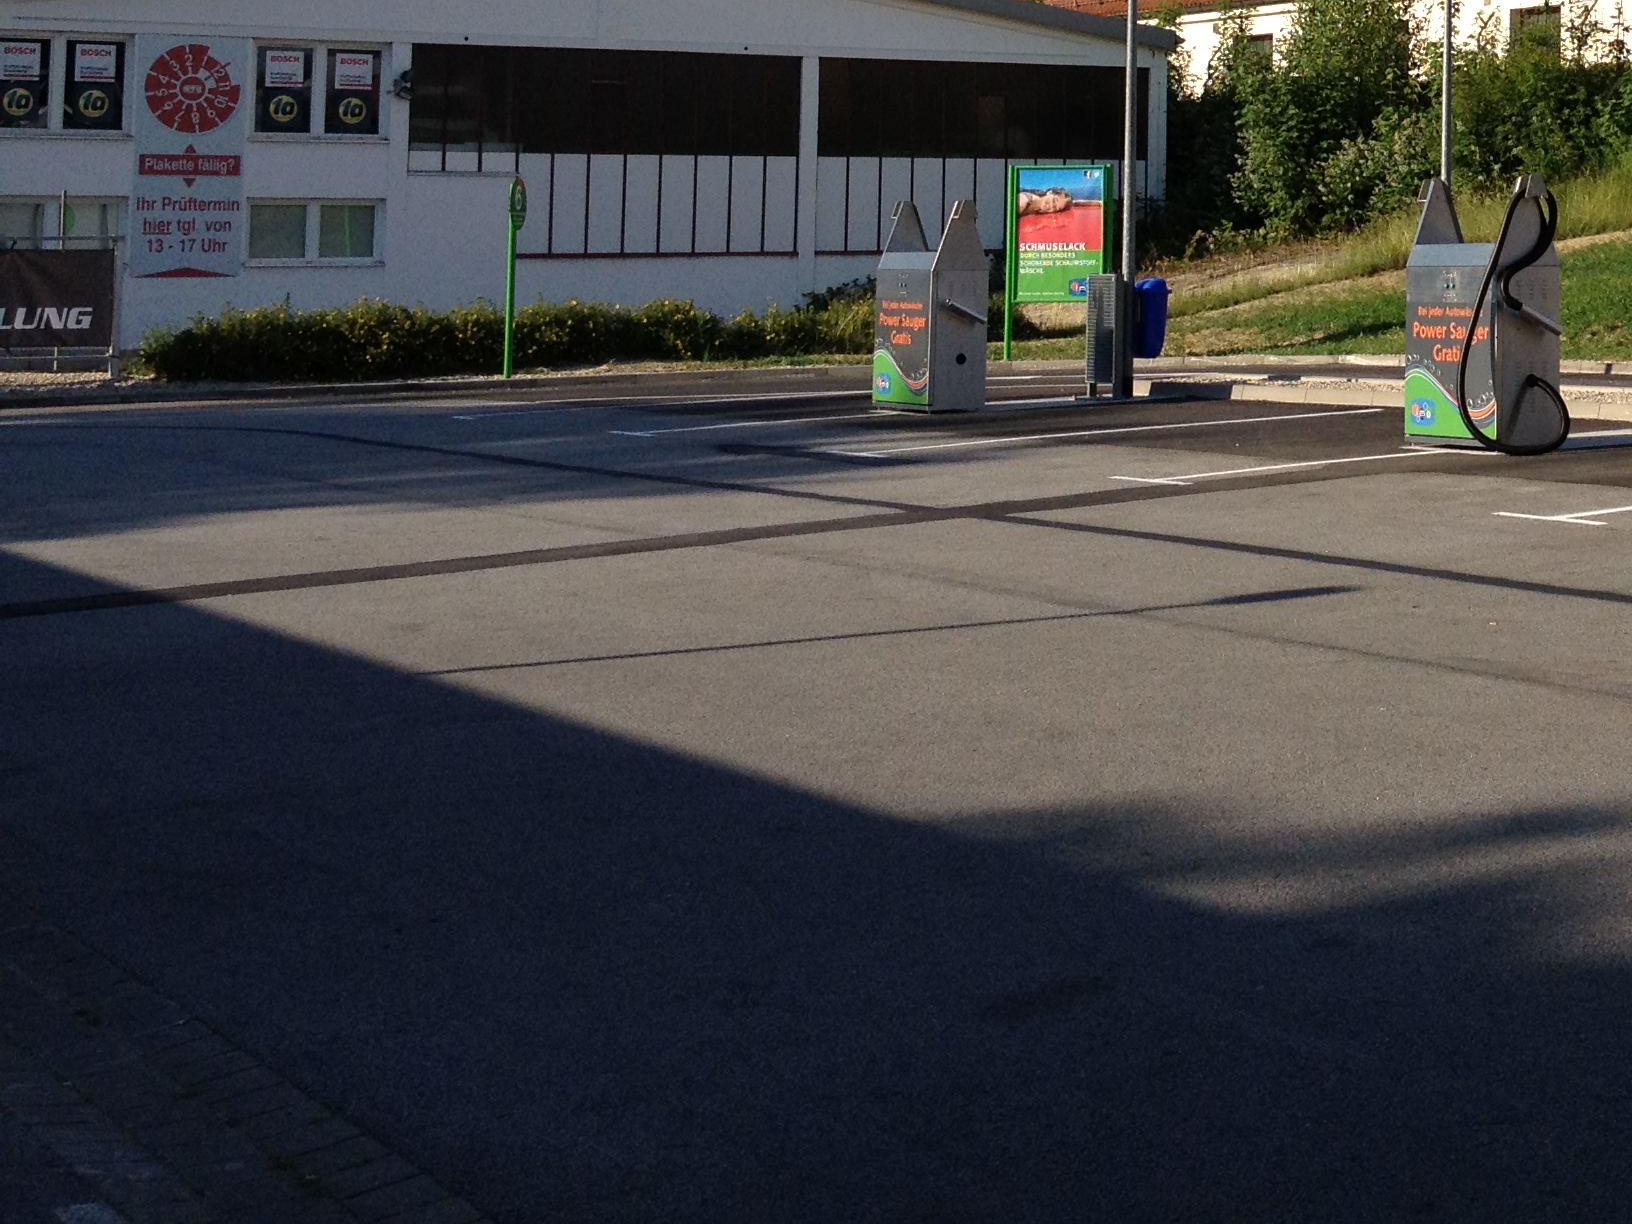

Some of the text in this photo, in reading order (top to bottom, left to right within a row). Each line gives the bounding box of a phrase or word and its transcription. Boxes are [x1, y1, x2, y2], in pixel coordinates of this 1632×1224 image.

[4, 47, 37, 55] BOSCH
[80, 49, 112, 57] BOSCH
[169, 60, 179, 71] 3
[184, 54, 193, 66] 2
[270, 55, 300, 63] BOSCH
[340, 58, 369, 66] BOSCH
[145, 158, 235, 175] Plakette fällig?
[136, 196, 240, 211] Ihr Prüftermin
[142, 217, 172, 234] hier
[205, 220, 232, 232] von
[147, 238, 164, 253] 13
[179, 238, 196, 253] 17
[201, 238, 228, 253] Uhr
[1020, 242, 1086, 251] SCHMUSELACK
[0, 307, 93, 329] LUNG
[1413, 321, 1447, 339] Power
[1433, 344, 1460, 362] Grati
